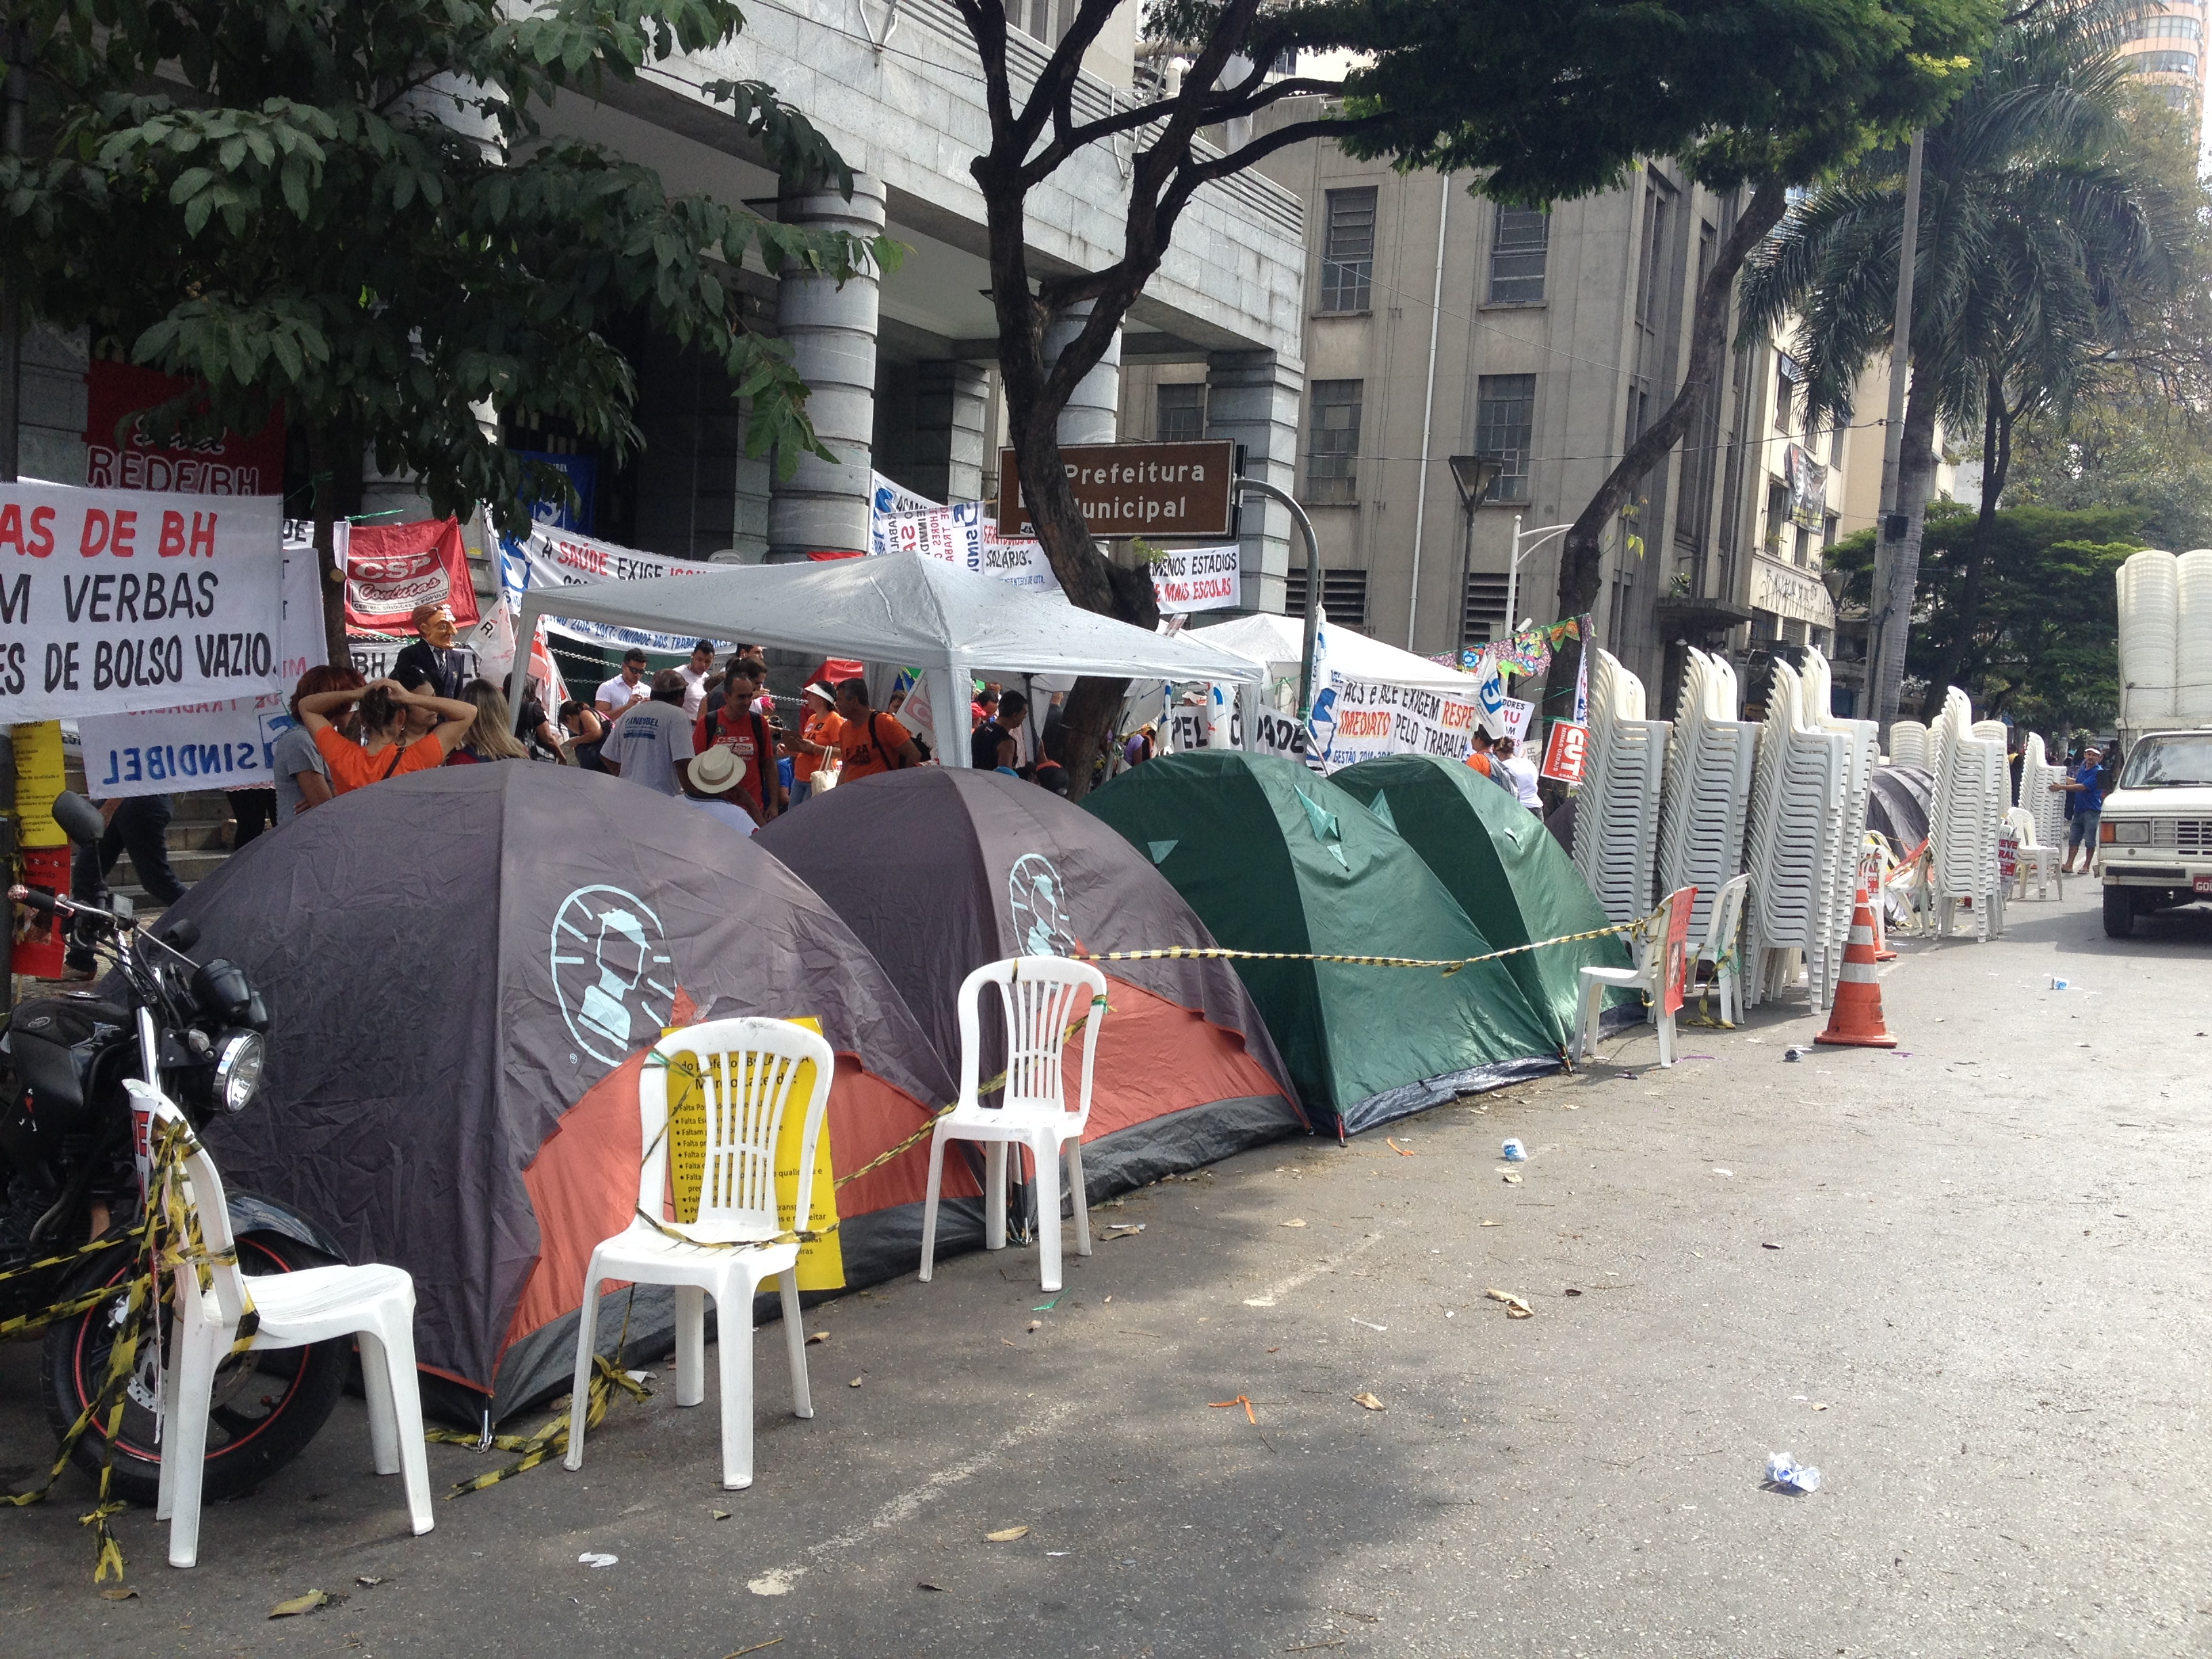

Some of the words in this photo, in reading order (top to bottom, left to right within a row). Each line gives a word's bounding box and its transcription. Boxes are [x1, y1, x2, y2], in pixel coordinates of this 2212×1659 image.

[1064, 461, 1204, 485] Prefeitura
[1075, 495, 1185, 523] unicipal
[80, 508, 137, 558] DE
[158, 510, 218, 558] BH
[354, 556, 431, 579] CSP
[542, 537, 552, 559] A
[558, 543, 608, 575] SAÚDE
[617, 557, 663, 581] EXIGE
[1191, 551, 1237, 575] ESTÁDIOS
[64, 571, 218, 623] VERBAS
[359, 577, 441, 600] Conlutas
[1165, 581, 1189, 602] MAIS
[1193, 577, 1231, 600] ESCOLAS
[354, 602, 381, 611] CENTRAL
[618, 628, 652, 645] UNIDADE
[653, 634, 668, 649] DOS
[45, 642, 79, 693] DE
[94, 634, 182, 691] BOLSO
[195, 632, 277, 678] VAZIO.
[352, 652, 386, 678] BH
[1402, 688, 1441, 722] EXIGEM
[1338, 710, 1391, 737] IMEDIATO
[1395, 713, 1418, 745] PELO
[1559, 727, 1567, 747] MINAS
[1333, 747, 1355, 764] GESTÃO
[1553, 748, 1562, 771] GERAIS
[1561, 729, 1584, 776] CUT
